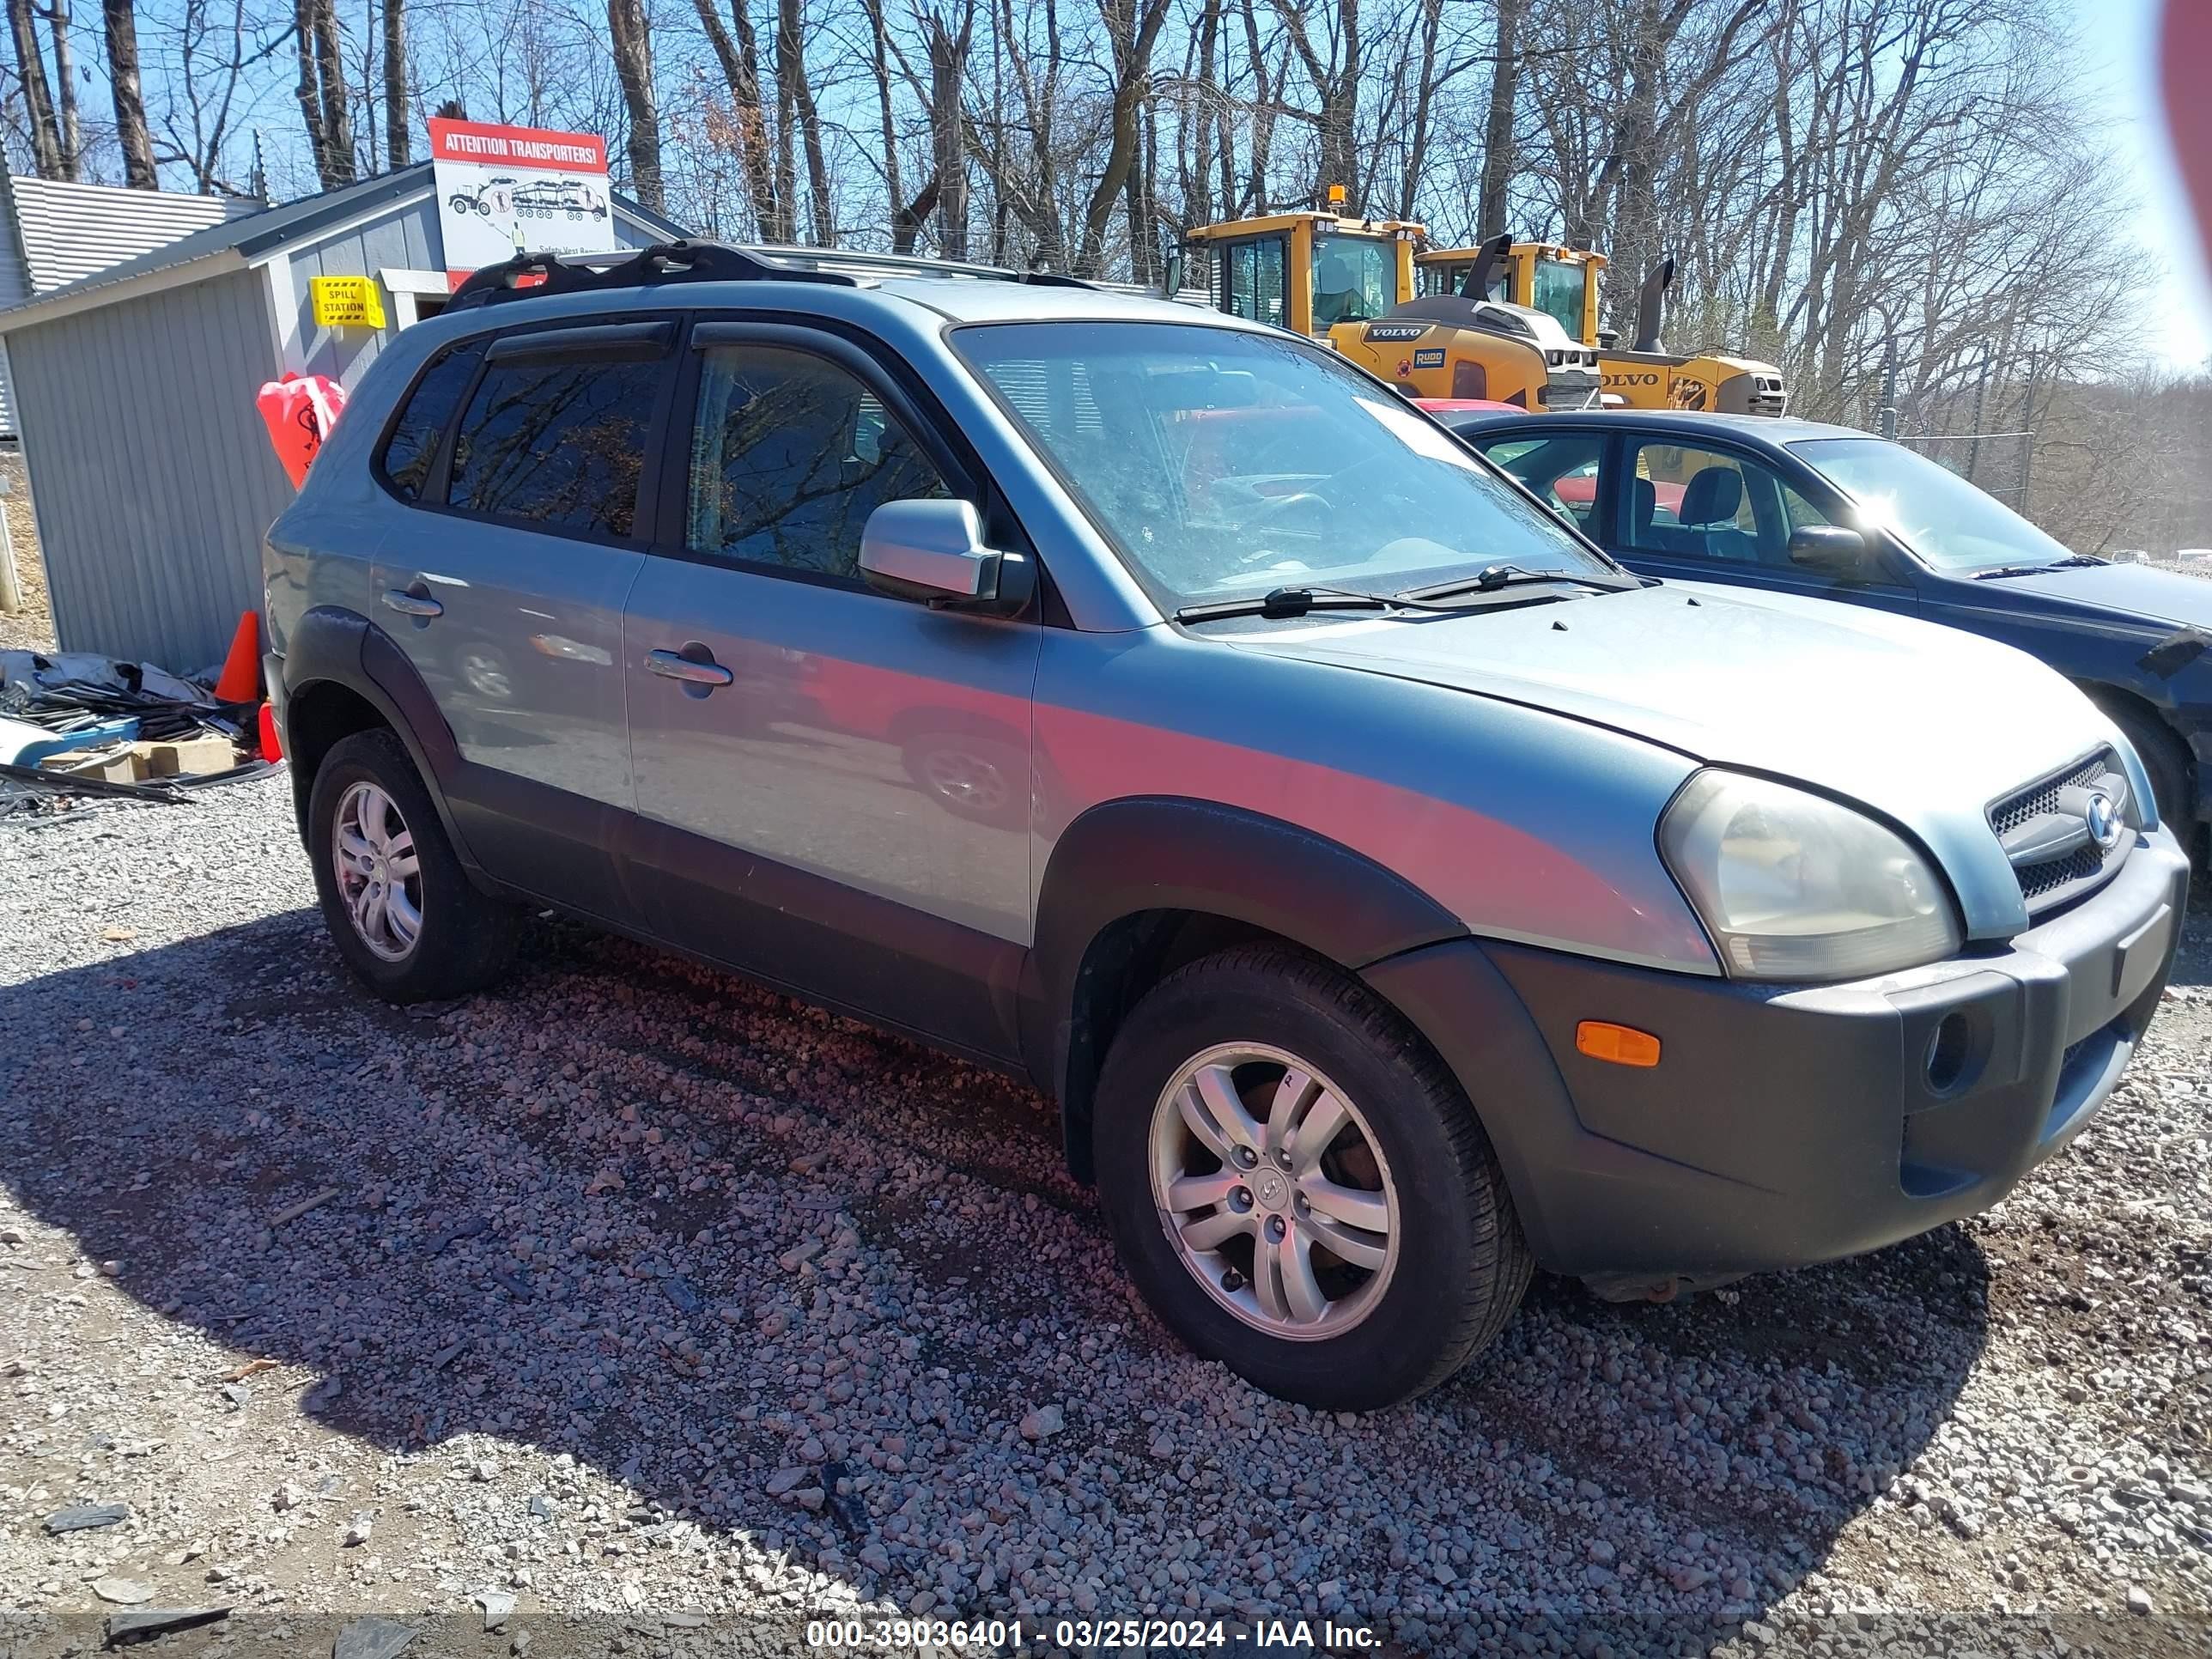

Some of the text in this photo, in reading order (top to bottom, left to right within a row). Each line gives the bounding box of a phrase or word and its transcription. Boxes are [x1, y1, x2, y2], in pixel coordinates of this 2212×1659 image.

[446, 133, 598, 165] ATTENTION TRANSPORTERS!
[329, 290, 356, 300] SPILL
[324, 302, 364, 312] STATION
[1416, 352, 1443, 365] RUDD
[1601, 374, 1659, 386] OLVO
